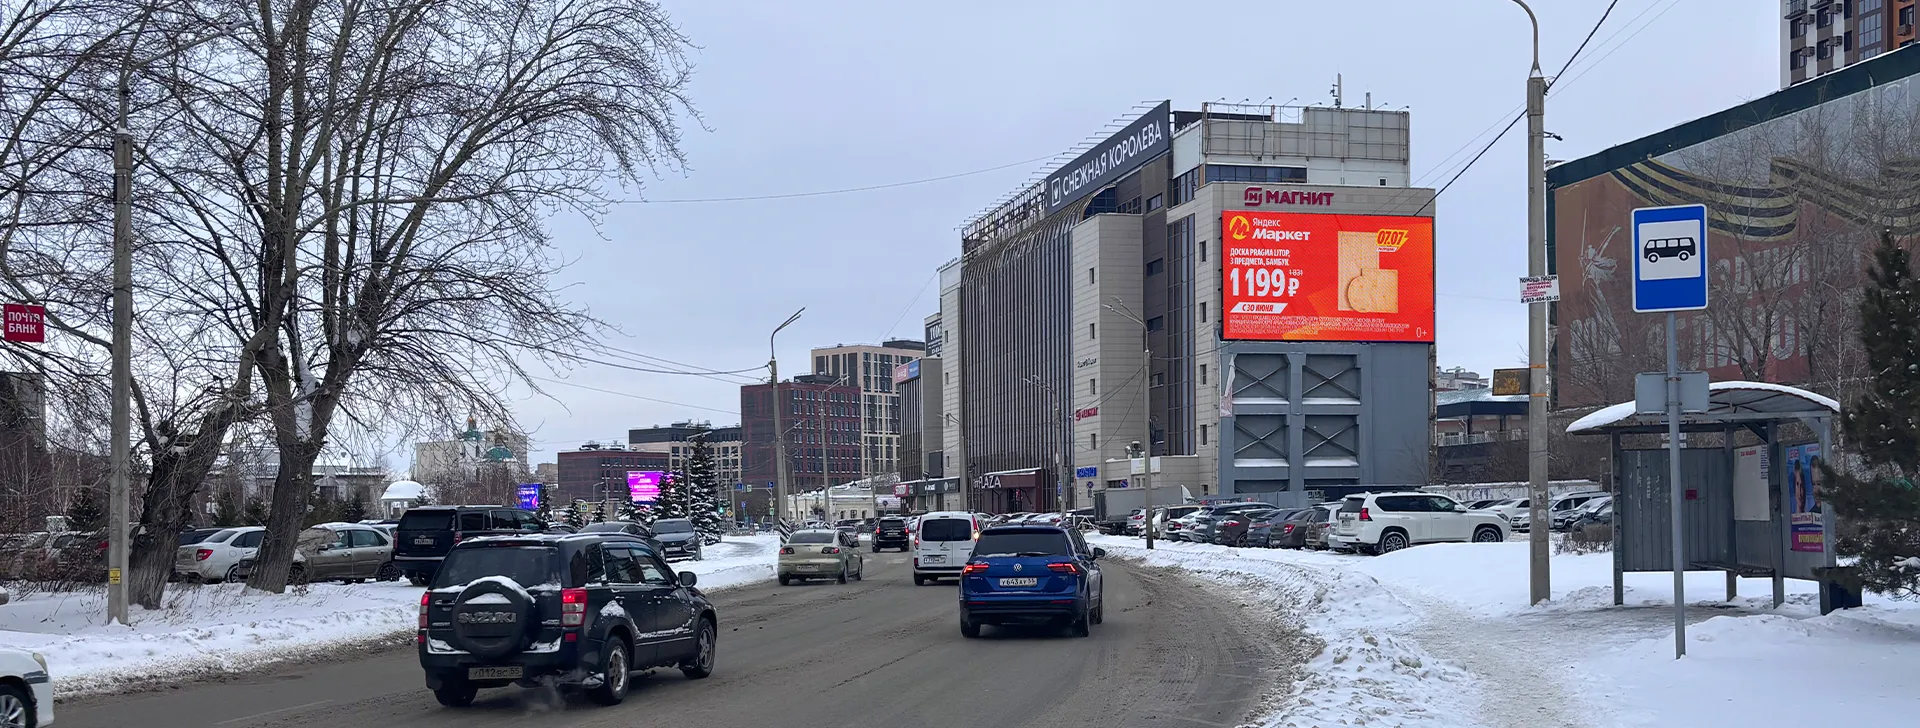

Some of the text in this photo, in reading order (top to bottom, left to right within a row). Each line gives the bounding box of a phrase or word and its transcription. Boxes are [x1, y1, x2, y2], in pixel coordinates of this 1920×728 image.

[1062, 119, 1162, 196] СНЕЖНАЯ КОРОЛЕВА
[1265, 190, 1334, 206] МАГНИТ
[1252, 217, 1281, 228] Яндекс
[1252, 228, 1311, 242] Маркет
[1377, 230, 1405, 245] 07.07
[1230, 247, 1249, 257] ДОСКА
[1230, 268, 1240, 296] 1
[1245, 268, 1286, 297] 199
[1247, 304, 1255, 312] 30
[8, 311, 41, 334] ПОЧТА БАНК
[1416, 327, 1427, 338] 0+
[458, 611, 517, 623] SUZUKI
